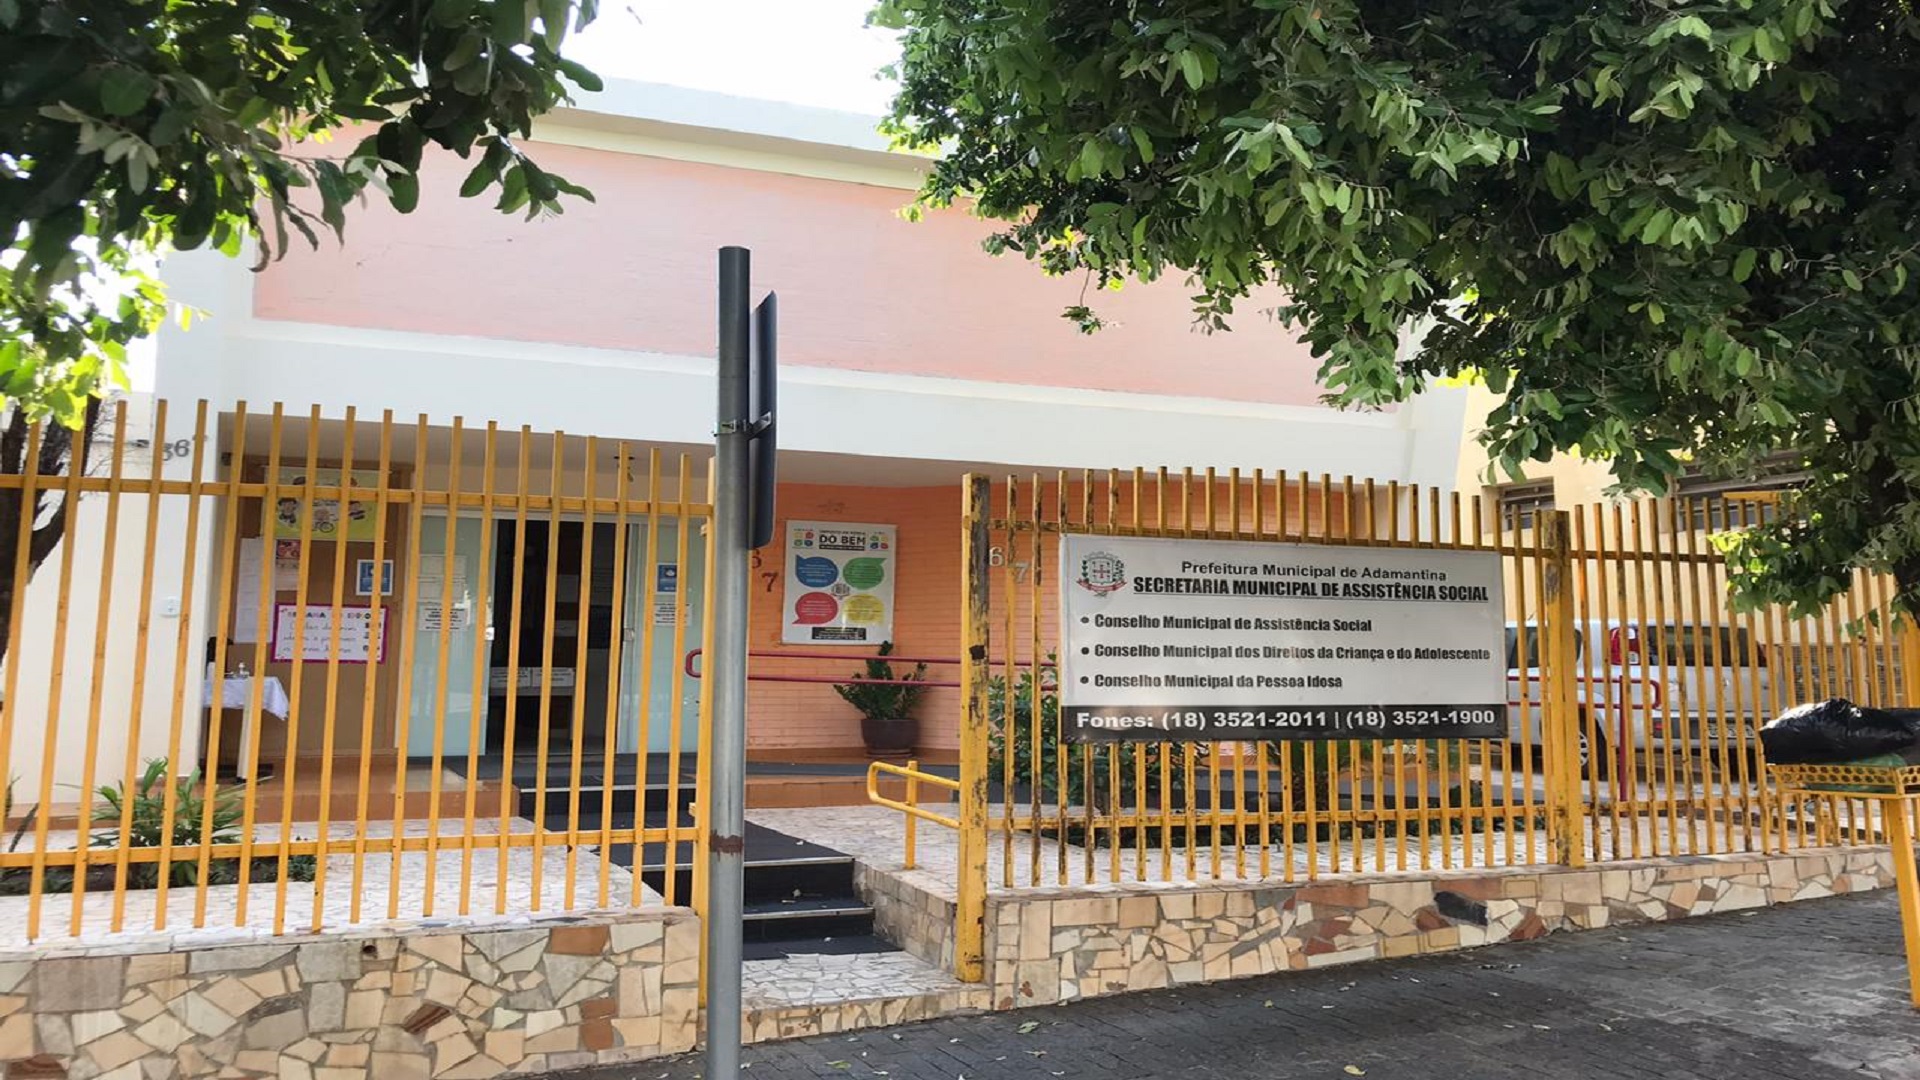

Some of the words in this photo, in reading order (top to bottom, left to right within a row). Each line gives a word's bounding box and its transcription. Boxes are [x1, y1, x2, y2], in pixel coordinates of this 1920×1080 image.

[819, 534, 838, 544] DO
[841, 535, 866, 546] BEM
[1181, 561, 1258, 575] Prefeitura
[1262, 564, 1336, 579] Municipal
[1340, 567, 1358, 578] de
[1361, 567, 1447, 581] Adamantina
[1133, 577, 1229, 594] SECRETARIA
[1232, 580, 1317, 596] MUNICIPAL
[1321, 582, 1339, 597] DE
[1342, 582, 1437, 600] ASSISTÊNCIA
[1439, 586, 1489, 601] SOCIAL
[1095, 614, 1160, 629] Conselho
[1163, 615, 1231, 631] Municipal
[1234, 616, 1251, 630] de
[1254, 617, 1331, 631] Assistência
[1333, 619, 1372, 632] Social
[1095, 644, 1160, 657] Conselho
[1163, 645, 1232, 659] Municipal
[1235, 646, 1260, 658] dos
[1263, 646, 1315, 659] Direitos
[1317, 647, 1334, 659] da
[1336, 647, 1385, 662] Criança
[1386, 649, 1395, 659] e
[1397, 648, 1412, 660] do
[1414, 648, 1490, 660] Adolescente
[1094, 674, 1162, 687] Conselho
[1164, 675, 1233, 689] Municipal
[1236, 675, 1254, 688] da
[1256, 675, 1305, 688] Pessoa
[1307, 676, 1342, 688] Idosa
[1076, 712, 1153, 728] Fones:
[1162, 711, 1206, 731] (18)
[1213, 711, 1327, 728] 3521-2011
[1346, 710, 1386, 729] (18)
[1393, 710, 1495, 725] 3521-1900
